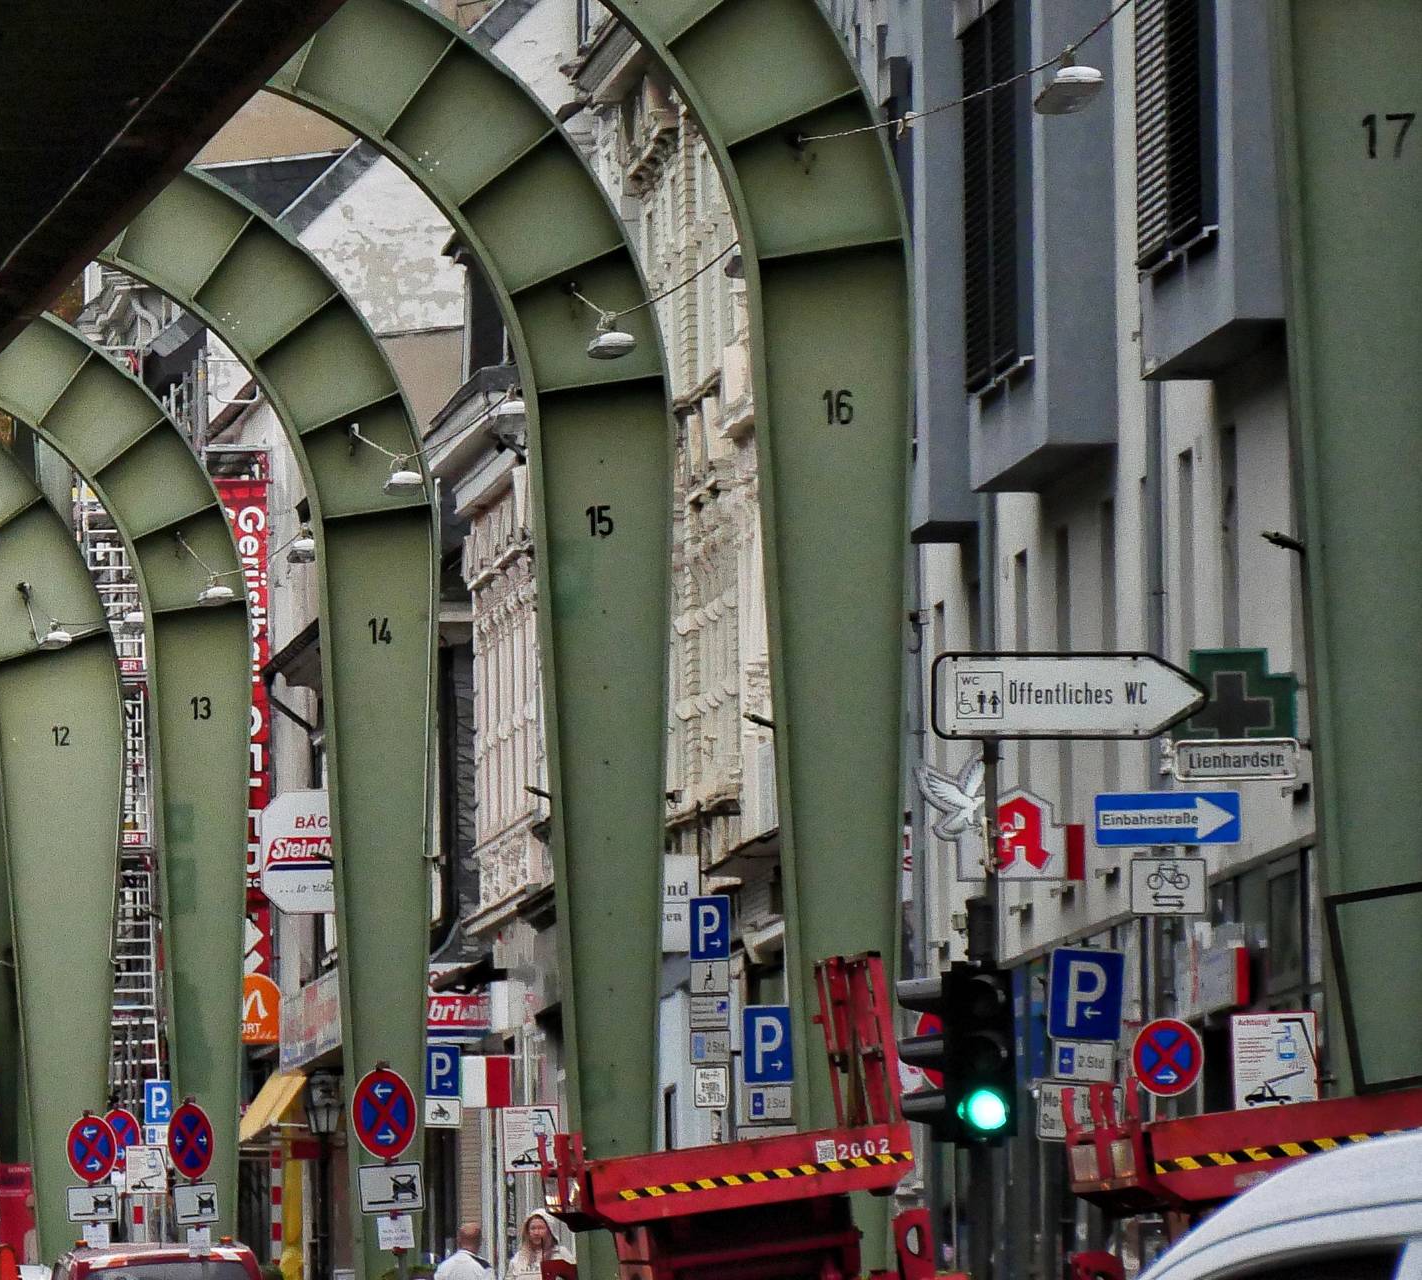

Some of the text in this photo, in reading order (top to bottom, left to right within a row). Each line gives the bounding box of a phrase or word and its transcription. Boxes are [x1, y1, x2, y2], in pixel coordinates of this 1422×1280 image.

[1362, 113, 1415, 159] 17
[823, 390, 853, 425] 16
[586, 505, 614, 536] 15
[368, 617, 392, 644] 14
[961, 676, 979, 685] WC
[1008, 680, 1148, 705] Öffentliches WC
[191, 696, 211, 720] 13
[52, 726, 70, 746] 12
[1102, 813, 1198, 826] Einbahnstraße
[838, 1138, 890, 1160] 2002
